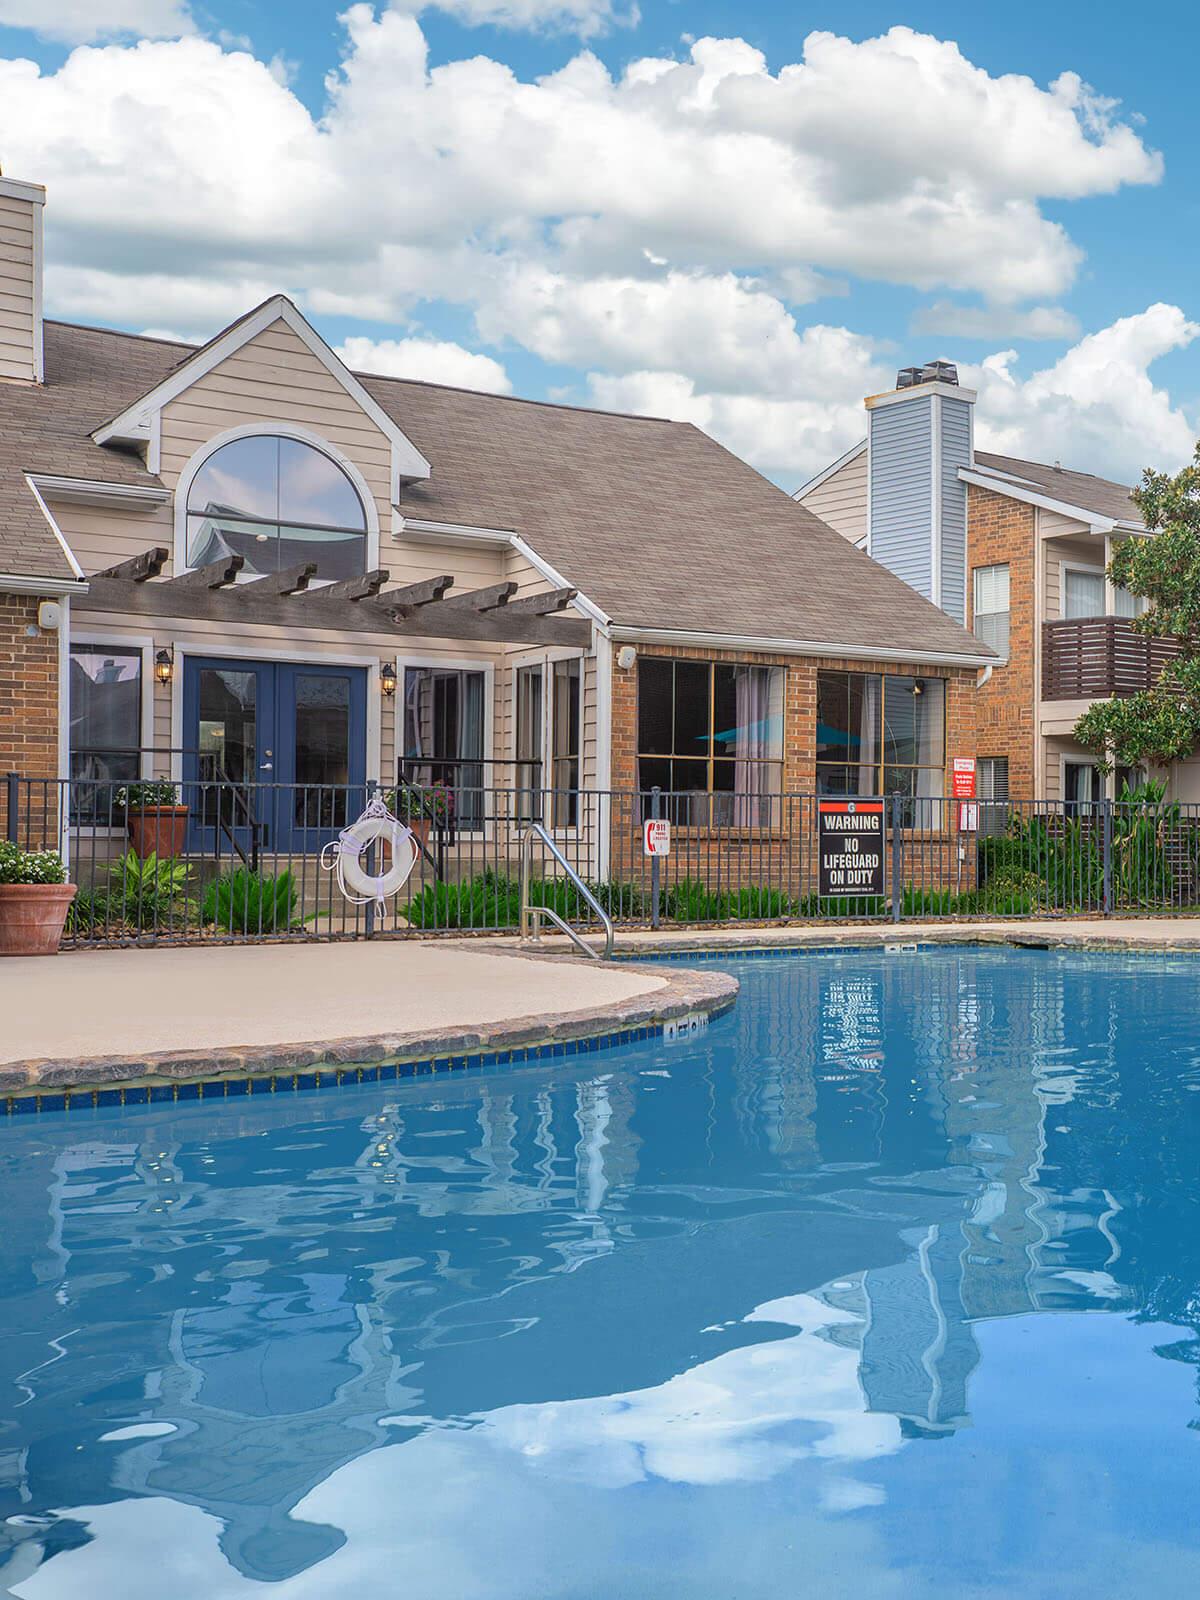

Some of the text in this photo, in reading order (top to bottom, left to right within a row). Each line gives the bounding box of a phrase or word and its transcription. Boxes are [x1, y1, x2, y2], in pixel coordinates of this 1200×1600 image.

[824, 815, 879, 830] WARNING
[844, 838, 859, 853] NO
[823, 854, 879, 869] LIFEGUARD
[830, 870, 873, 884] ON DUTY
